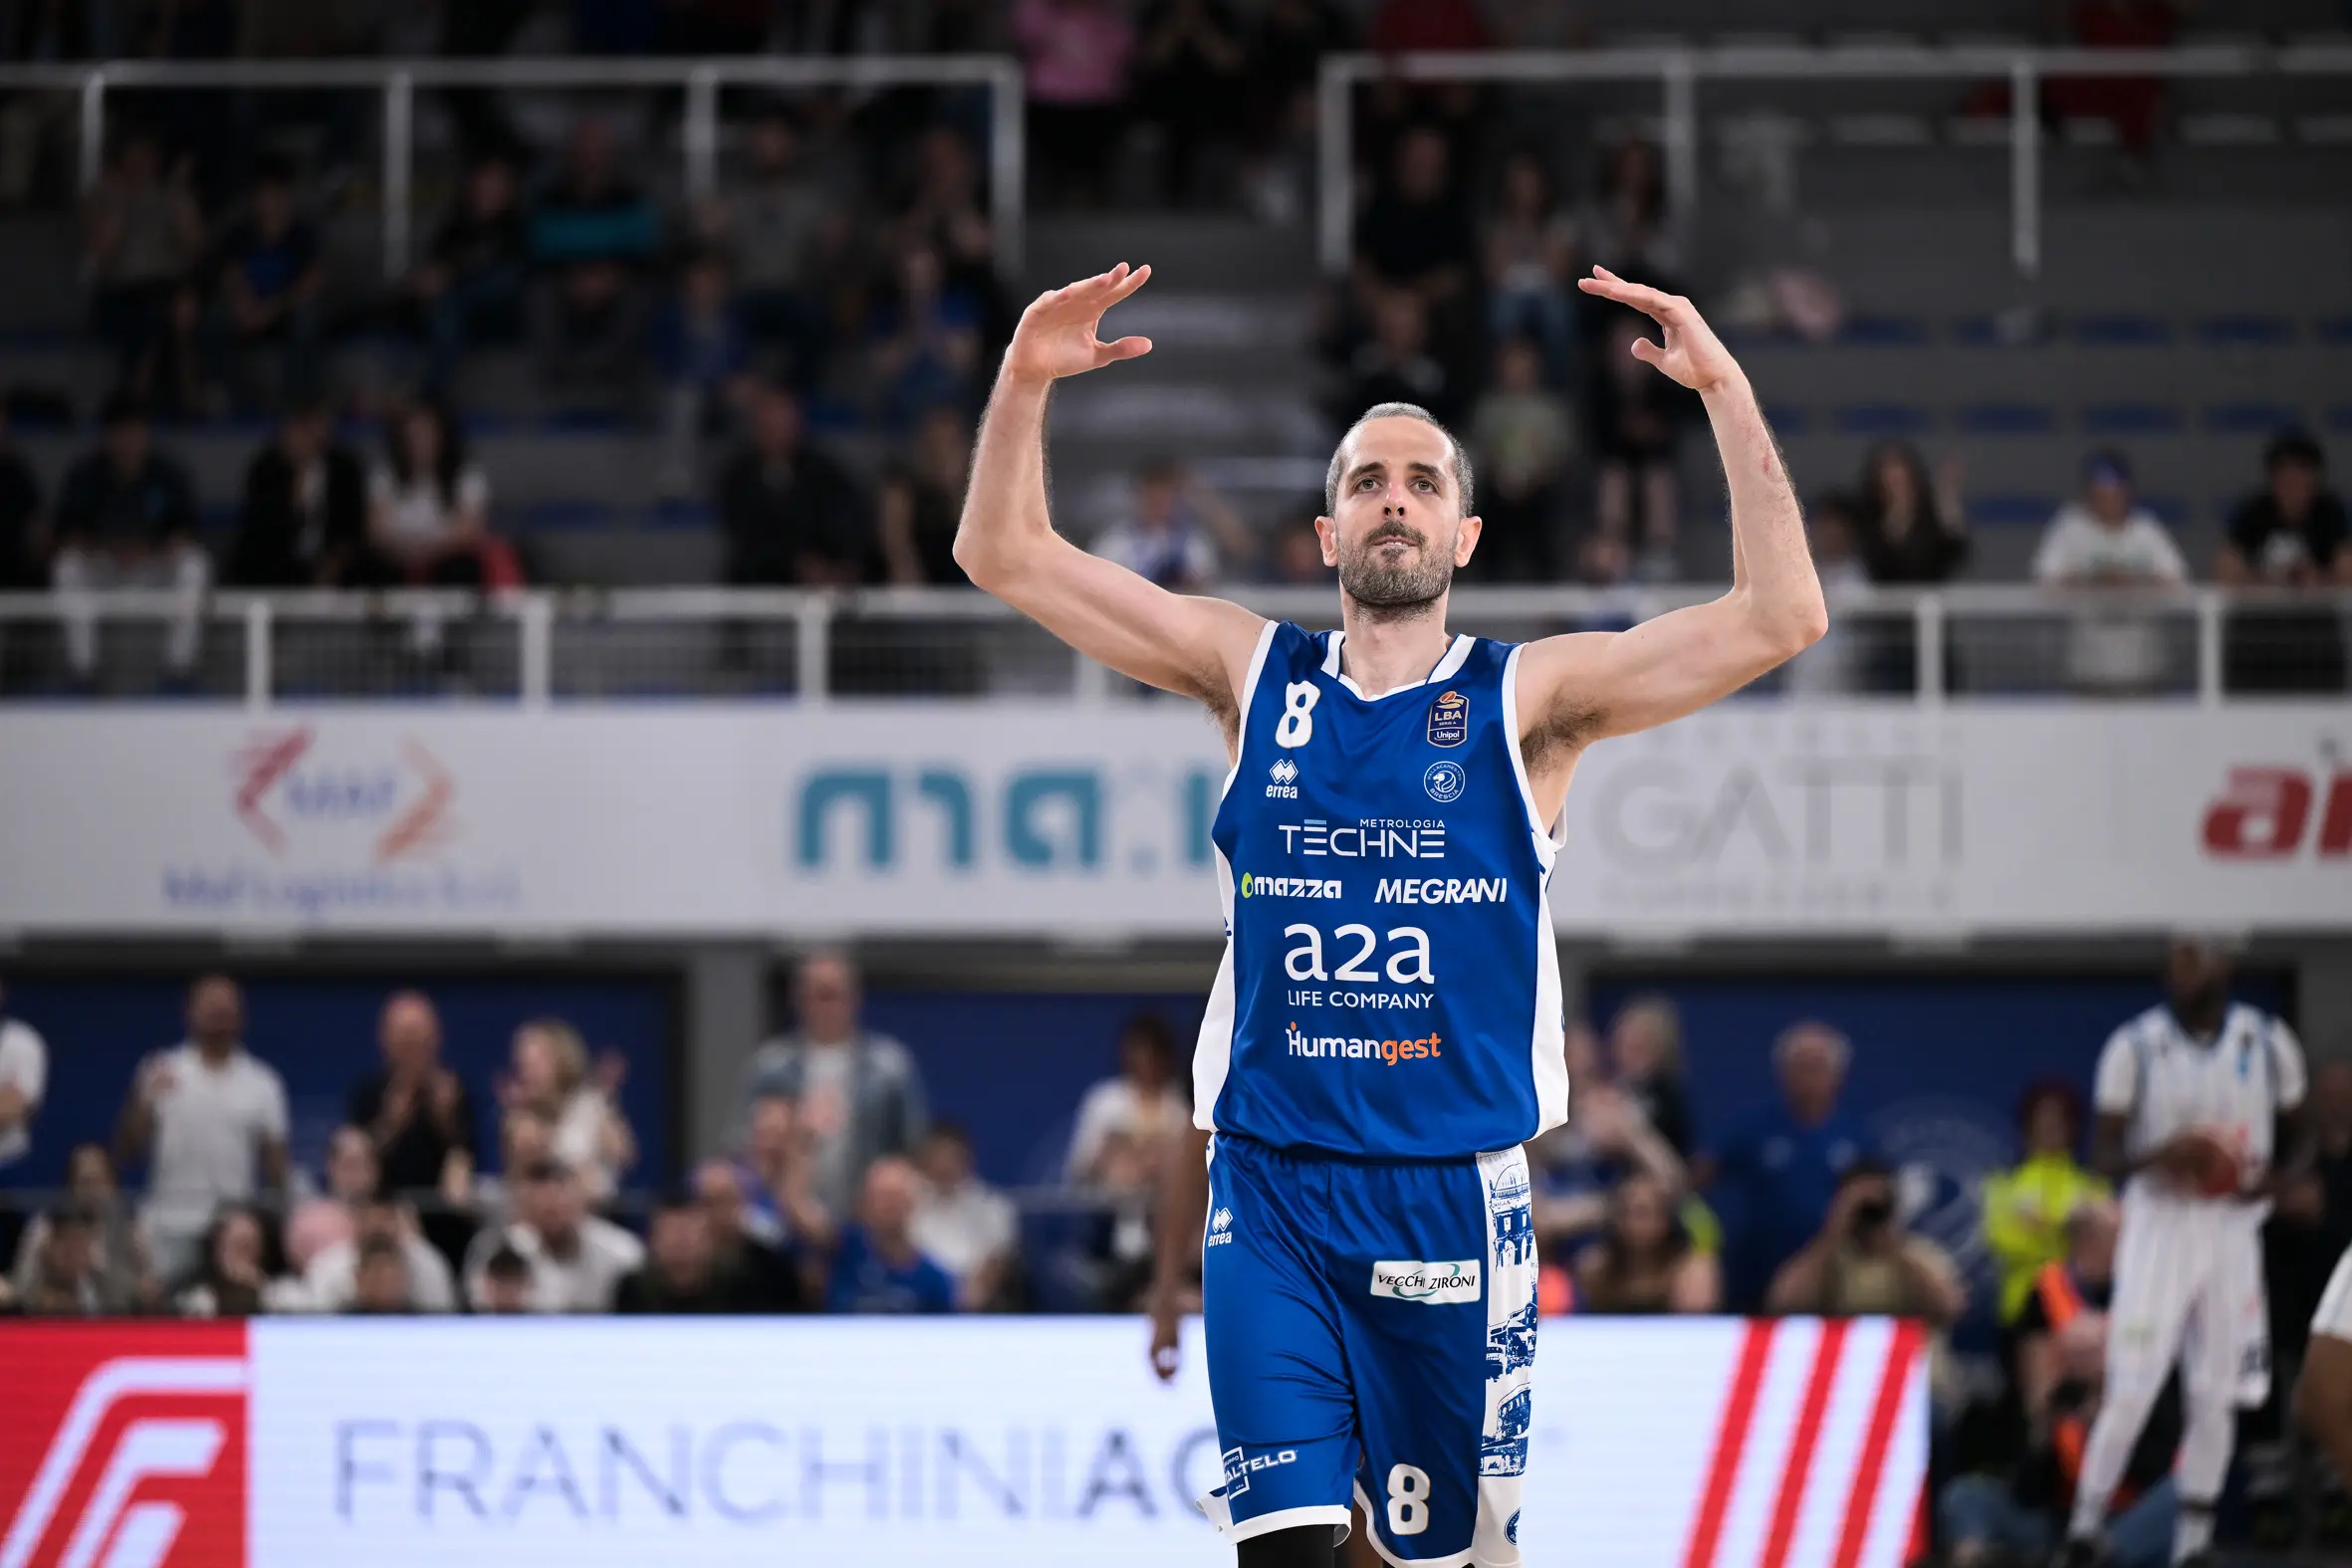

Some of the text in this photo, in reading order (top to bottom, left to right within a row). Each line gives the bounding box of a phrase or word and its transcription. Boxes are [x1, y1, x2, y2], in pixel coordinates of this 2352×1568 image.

[1276, 680, 1320, 749] 8
[1434, 710, 1462, 721] LBA
[1436, 730, 1460, 741] Unipol
[1266, 784, 1298, 799] errea
[1429, 787, 1459, 799] BRESCIA
[1359, 818, 1446, 828] METROLOGIA
[1278, 819, 1446, 858] TECHNE
[1374, 878, 1508, 905] MEGRANI
[1284, 923, 1435, 985] a2a
[1288, 990, 1435, 1009] LIFE COMPANY
[1286, 1021, 1442, 1066] Humangest
[1208, 1231, 1233, 1247] errea
[1378, 1275, 1476, 1290] VECCHI ZIRONI
[1226, 1449, 1297, 1483] ALTELO
[1387, 1462, 1431, 1536] 8
